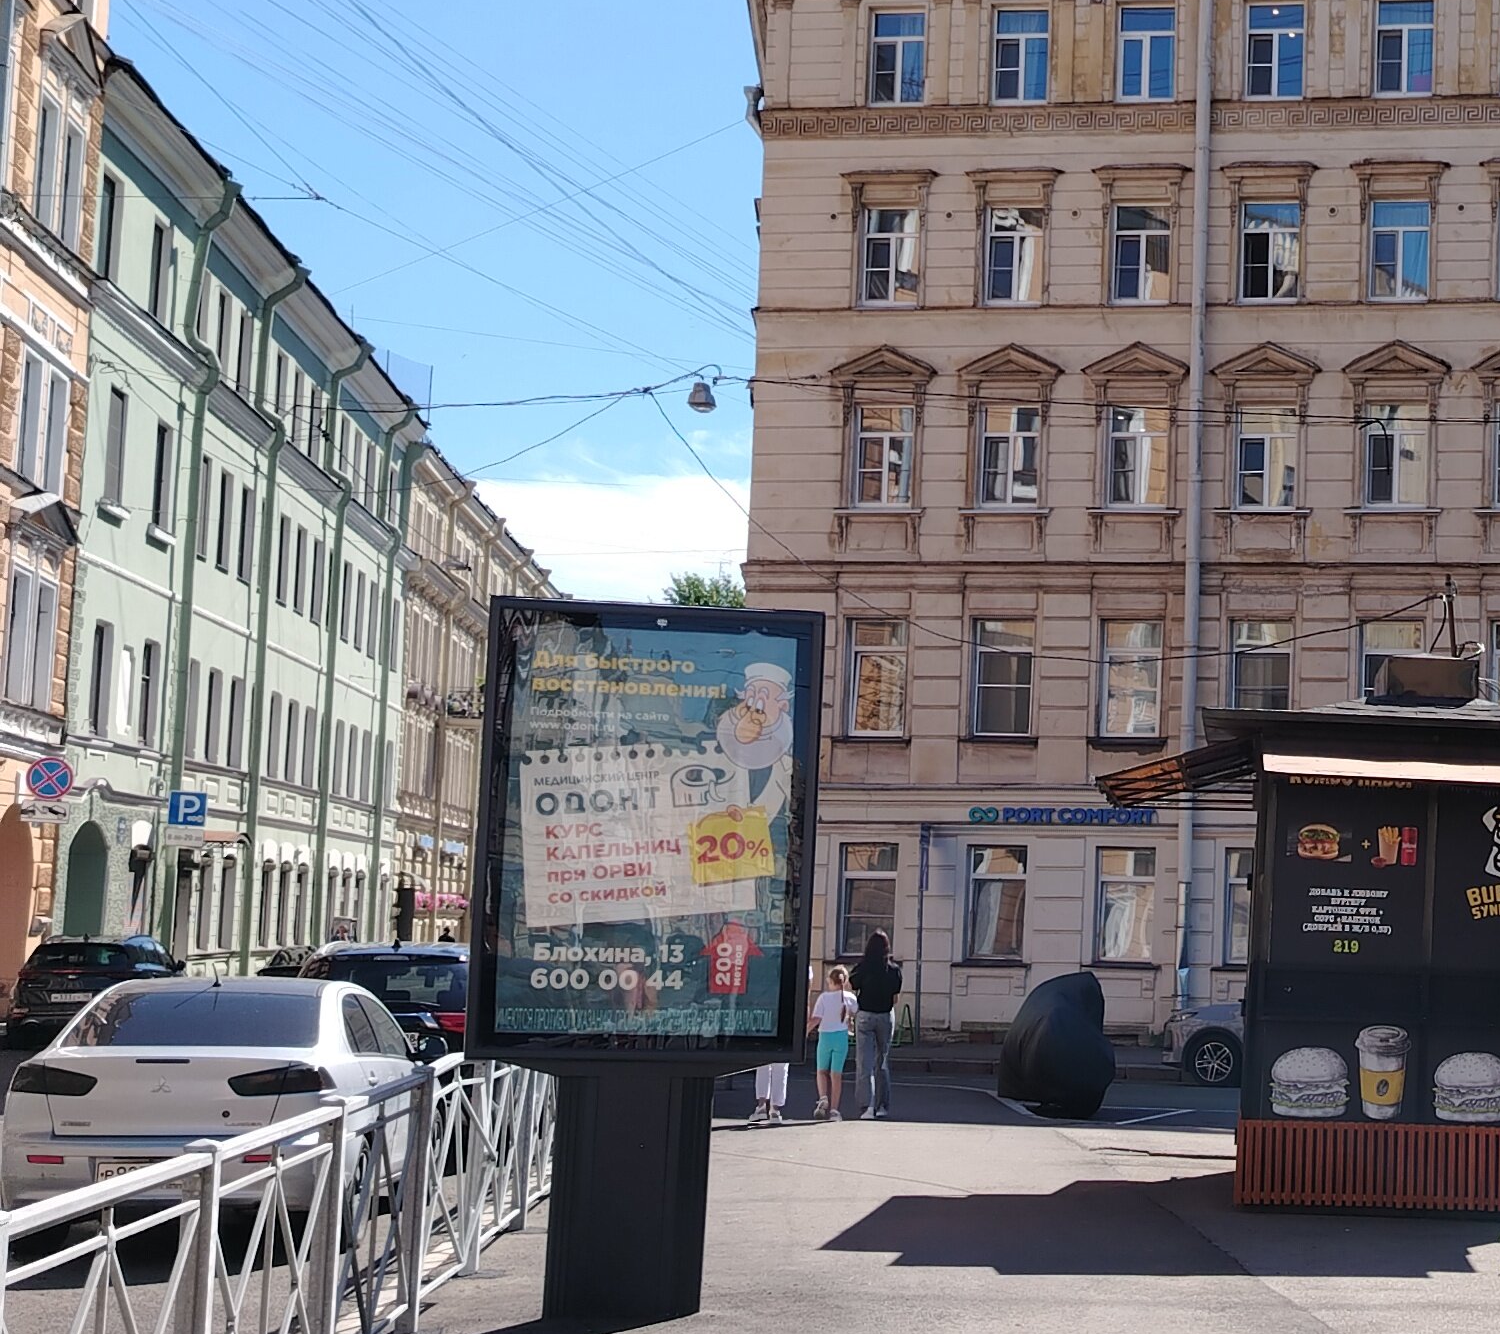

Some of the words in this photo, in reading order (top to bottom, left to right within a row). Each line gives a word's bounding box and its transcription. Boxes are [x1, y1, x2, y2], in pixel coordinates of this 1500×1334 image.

[533, 650, 576, 669] Для
[585, 653, 696, 674] быстрого
[532, 677, 727, 699] восстановления!
[530, 706, 614, 721] Подробности
[618, 711, 633, 720] на
[635, 710, 670, 721] сайте
[534, 772, 624, 786] МЕДИЦИНСКИЙ
[626, 770, 660, 783] ЦЕНТР
[1002, 807, 1056, 824] PORT
[1058, 807, 1155, 825] COMFORT
[545, 822, 603, 840] КУРС
[546, 838, 682, 862] КАПЕЛЬНИЦ
[696, 831, 769, 865] 20%
[547, 868, 585, 885] при
[593, 862, 652, 880] ОРВИ
[547, 891, 573, 904] со
[579, 882, 667, 902] скидкой
[533, 942, 650, 966] Блохина,
[659, 944, 684, 963] 13
[1333, 939, 1359, 953] 219
[715, 942, 733, 986] 200
[733, 944, 743, 986] метров
[530, 968, 590, 990] 600
[598, 969, 638, 991] 00
[646, 969, 684, 991] 44
